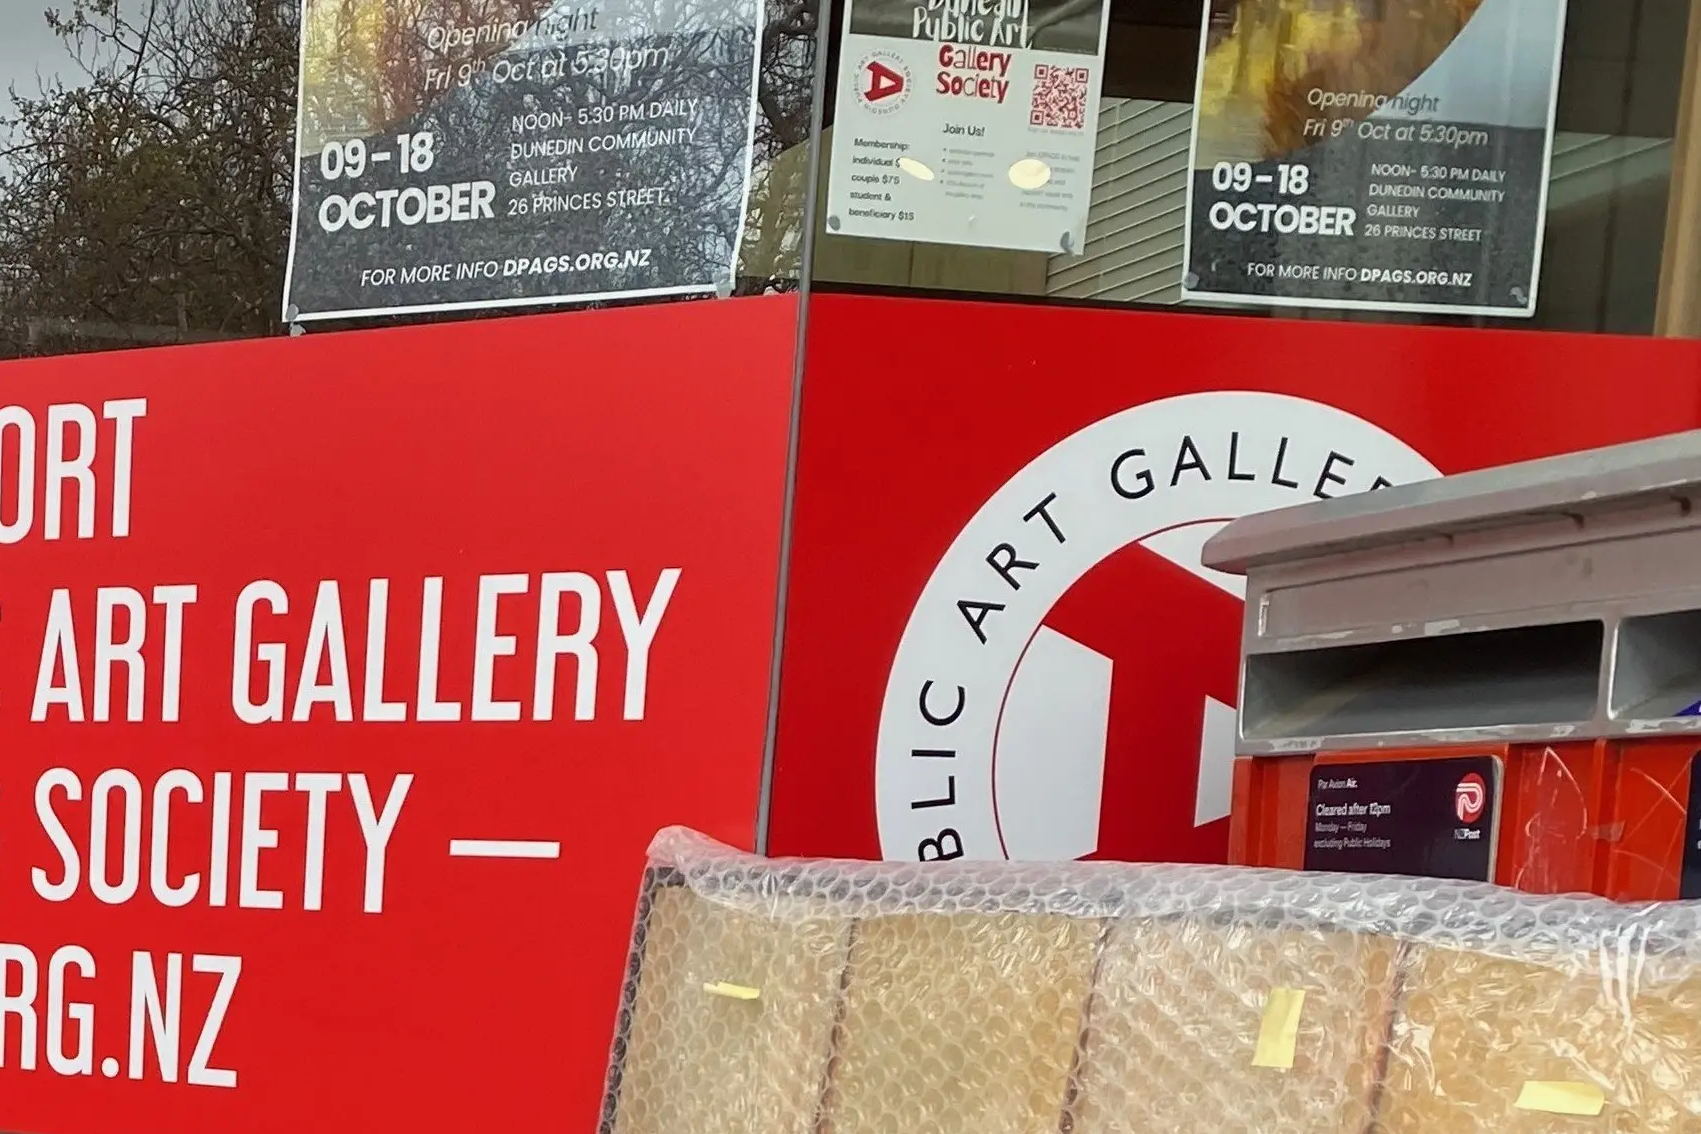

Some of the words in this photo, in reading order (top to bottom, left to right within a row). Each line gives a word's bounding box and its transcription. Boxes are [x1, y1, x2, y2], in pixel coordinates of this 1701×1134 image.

[428, 19, 529, 54] Opening
[535, 7, 599, 41] night
[912, 6, 985, 42] Public
[989, 2, 1032, 49] Art
[424, 64, 451, 91] Fri
[458, 59, 486, 87] 9th
[492, 56, 535, 84] Oct
[541, 50, 566, 79] at
[939, 44, 1012, 77] Gallery
[936, 71, 1010, 104] Society
[619, 103, 645, 122] PM
[649, 98, 698, 119] DAILY
[1307, 87, 1388, 111] Opening
[1391, 93, 1440, 116] night
[943, 123, 965, 136] Join
[967, 125, 986, 137] Us!
[1303, 118, 1326, 137] Fri
[1331, 117, 1354, 138] 9th
[1357, 121, 1392, 139] Oct
[1395, 123, 1415, 142] at
[511, 138, 584, 159] DUNEDIN
[588, 128, 698, 152] COMMUNITY
[852, 155, 893, 166] individual
[509, 166, 578, 187] GALLERY
[851, 174, 880, 184] couple
[882, 174, 901, 185] $75
[1450, 167, 1469, 180] PM
[1471, 168, 1506, 183] DAILY
[507, 198, 529, 215] 26
[532, 192, 602, 213] PRINCES
[606, 187, 666, 207] STREET
[849, 190, 882, 200] student
[884, 193, 892, 201] &
[1368, 183, 1425, 198] DUNEDIN
[1427, 186, 1506, 202] COMMUNITY
[317, 179, 496, 233] OCTOBER
[848, 207, 896, 220] beneficiary
[897, 210, 915, 221] $15
[1366, 204, 1421, 218] GALLERY
[1209, 202, 1357, 237] OCTOBER
[1364, 223, 1381, 237] 26
[1384, 225, 1437, 239] PRINCES
[1438, 227, 1482, 242] STREET
[360, 268, 396, 287] FOR
[399, 265, 453, 285] MORE
[456, 261, 499, 282] INFO
[502, 248, 652, 277] DPAGS.ORG.NZ
[1247, 262, 1275, 278] FOR
[1278, 264, 1320, 281] MORE
[1323, 265, 1357, 282] INFO
[1360, 267, 1472, 288] DPAGS.ORG.NZ
[956, 491, 1067, 645] ART
[1110, 431, 1394, 500] GALLE
[29, 584, 198, 722] ART
[231, 567, 684, 725] GALLERY
[1317, 778, 1329, 790] Par
[1315, 802, 1347, 818] Cleared
[1348, 802, 1368, 816] after
[1369, 802, 1391, 818] 12pm
[1314, 821, 1340, 833] Monday
[1347, 821, 1368, 833] Friday
[31, 766, 415, 914] SOCIETY
[1313, 838, 1342, 850] excluding
[1343, 837, 1362, 848] Public
[1363, 837, 1391, 849] Holidays
